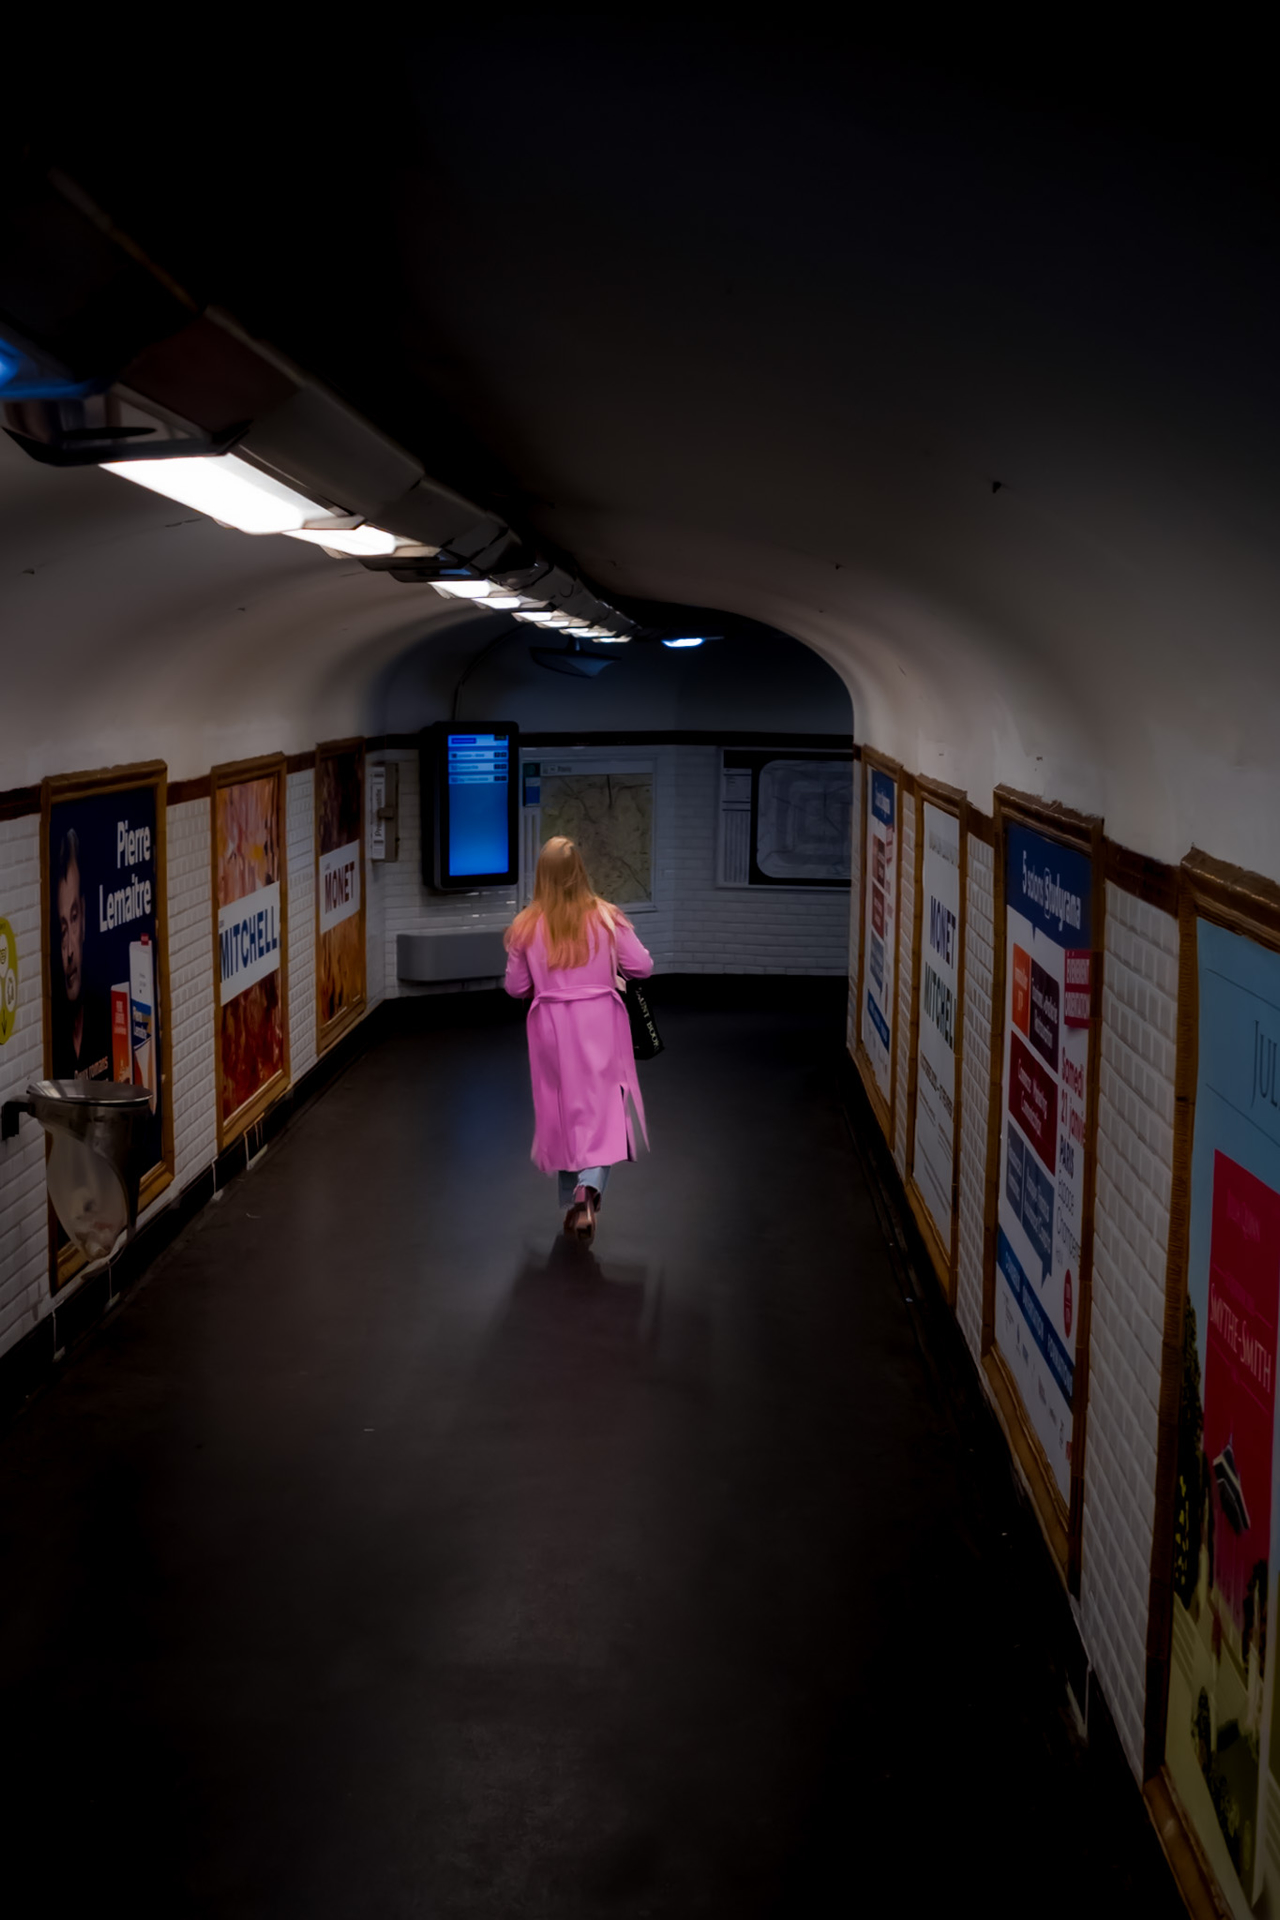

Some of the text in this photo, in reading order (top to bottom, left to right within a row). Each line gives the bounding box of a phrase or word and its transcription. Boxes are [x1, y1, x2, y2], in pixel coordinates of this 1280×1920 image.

[117, 819, 151, 869] Pierre
[324, 861, 355, 915] MONET
[218, 905, 278, 984] MITCHELL
[930, 894, 956, 969] MONET
[924, 961, 957, 1053] MITCHELL
[1251, 1019, 1280, 1111] JUL
[1060, 1133, 1075, 1178] PARIS
